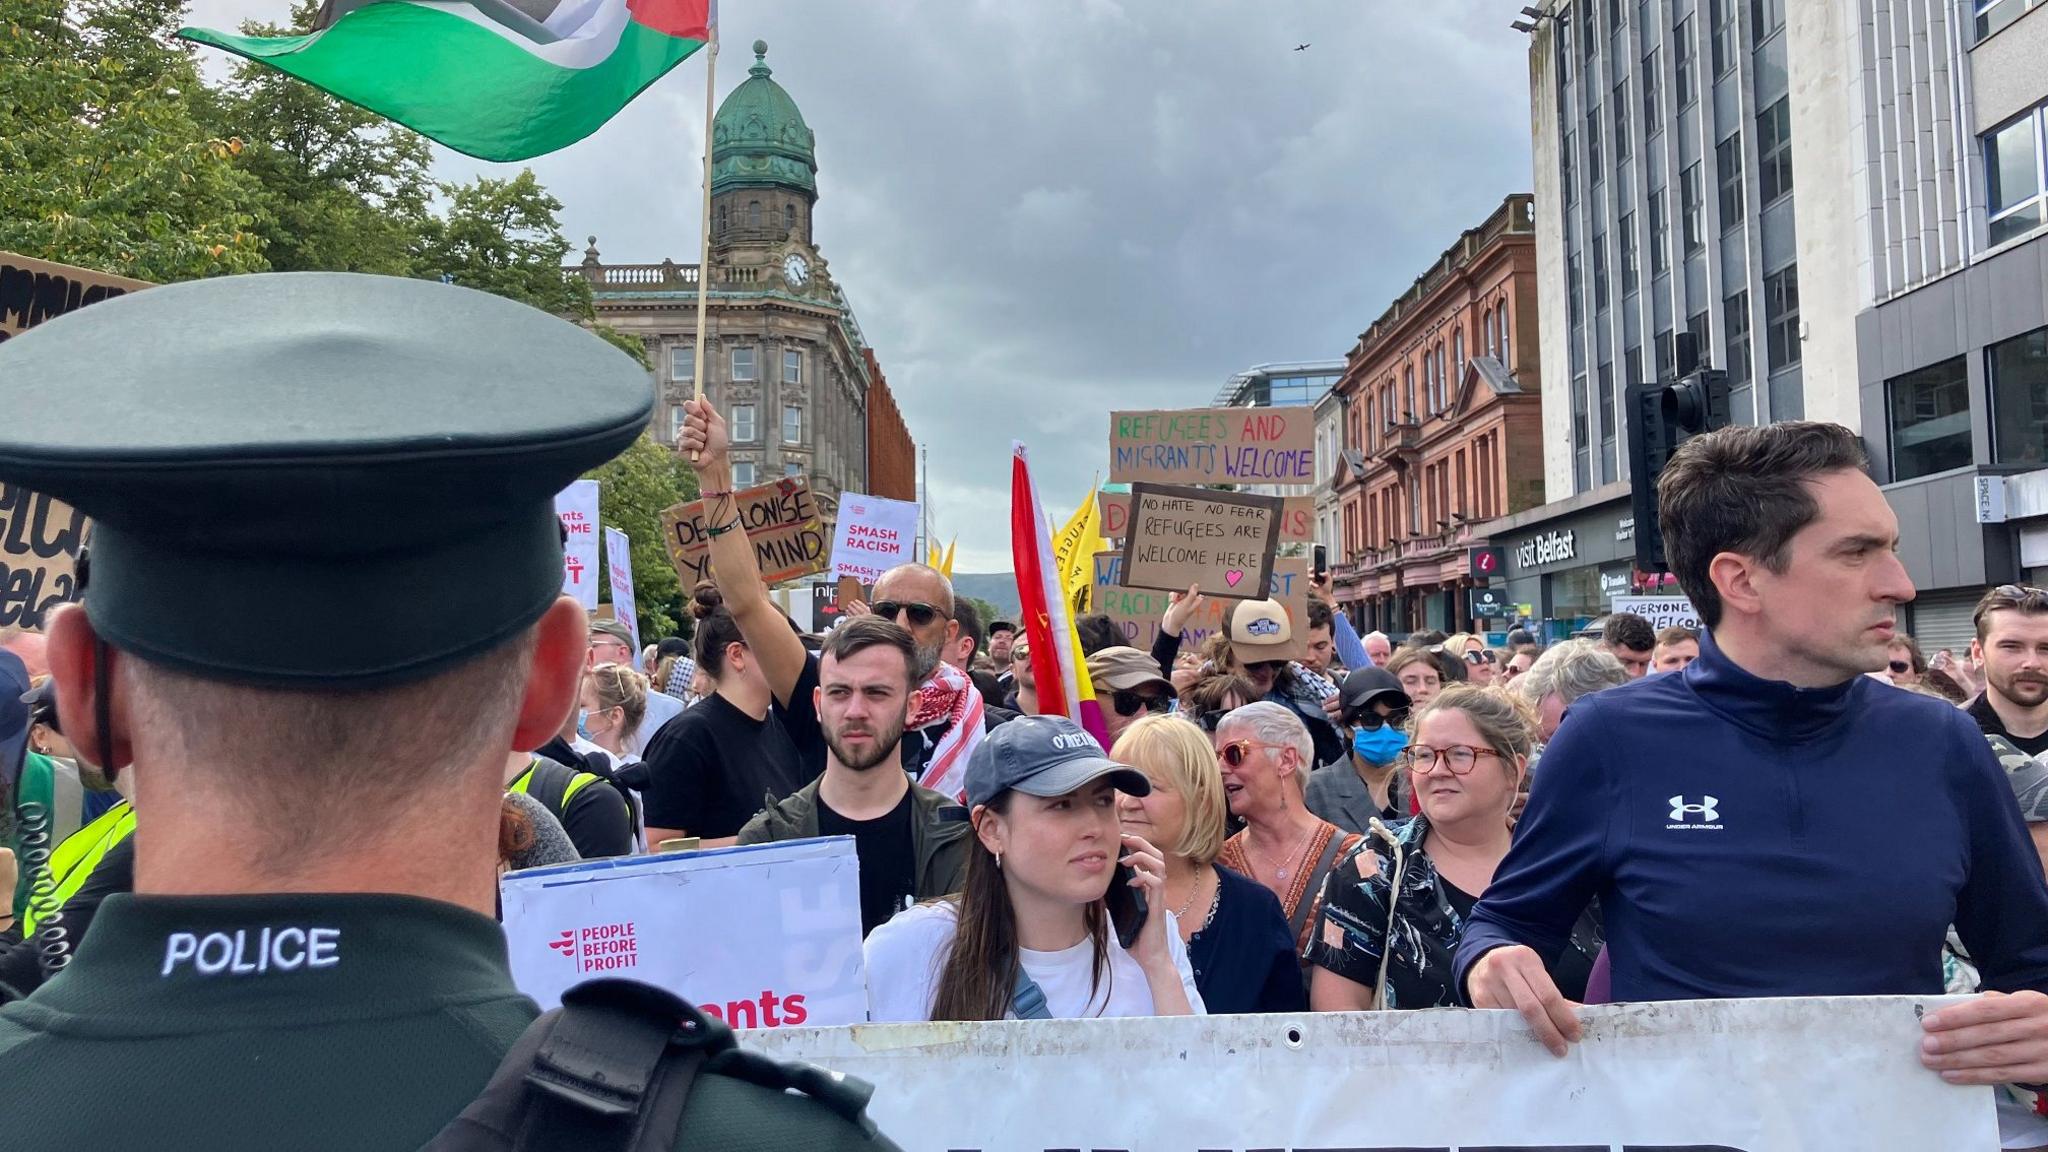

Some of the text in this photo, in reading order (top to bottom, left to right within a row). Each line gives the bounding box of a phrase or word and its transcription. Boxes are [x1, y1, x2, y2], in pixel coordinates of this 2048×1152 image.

[1119, 415, 1286, 442] REFUGEES AND
[1117, 444, 1313, 477] MIGRANTS WELCOME
[1142, 499, 1265, 520] NO HATE NO FEAR
[849, 525, 897, 540] SMASH
[1145, 516, 1262, 541] REFUGEES ARE
[847, 538, 900, 554] RACISM
[1138, 544, 1257, 567] WELCOME HERE
[1516, 530, 1574, 568] visit Belfast
[837, 563, 873, 575] SMASH
[1626, 602, 1689, 614] EVERYONE
[582, 922, 635, 941] PEOPLE
[161, 927, 341, 977] POLICE
[583, 938, 637, 957] BEFORE
[584, 953, 638, 972] PROFIT
